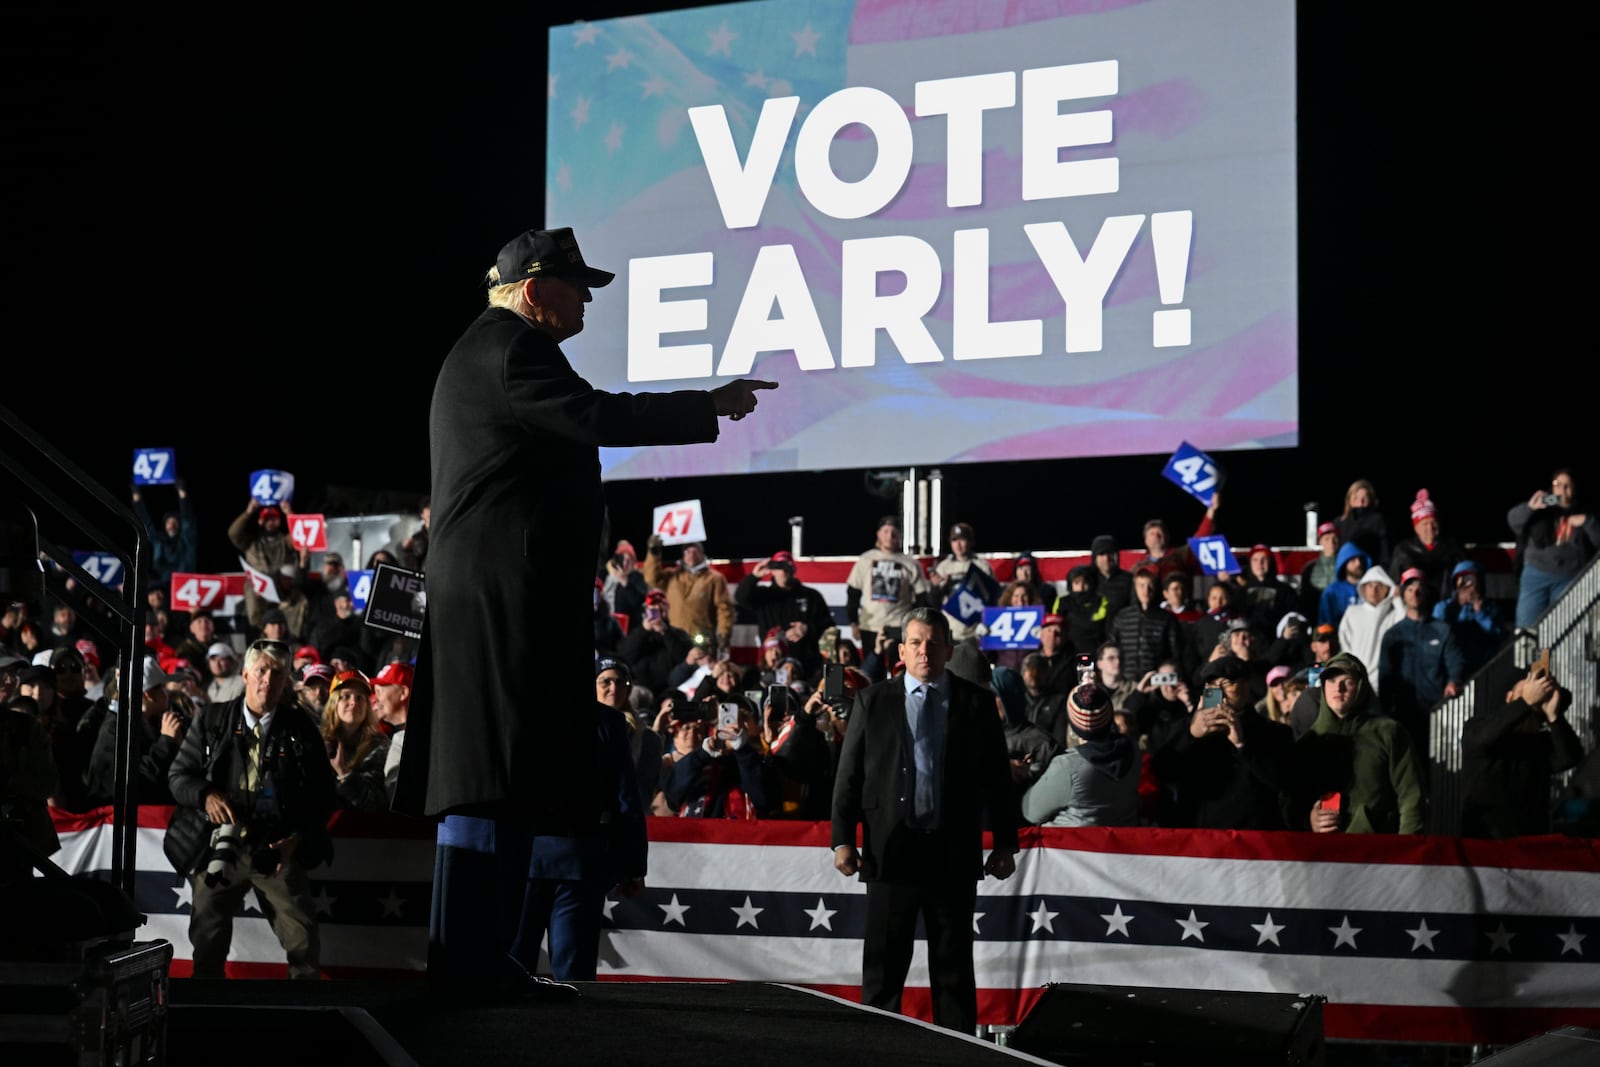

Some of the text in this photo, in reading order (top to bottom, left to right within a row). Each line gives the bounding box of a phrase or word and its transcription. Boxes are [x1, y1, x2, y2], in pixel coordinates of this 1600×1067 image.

[688, 60, 1119, 228] VOTE
[628, 211, 1192, 382] EARLY!
[133, 452, 170, 480] 47
[1172, 455, 1219, 493] 47
[252, 473, 291, 500] 47
[292, 519, 321, 548] 47
[657, 508, 694, 537] 47
[80, 556, 121, 584] 47
[1198, 540, 1226, 570] 47
[175, 578, 223, 608] 47
[988, 610, 1038, 642] 47
